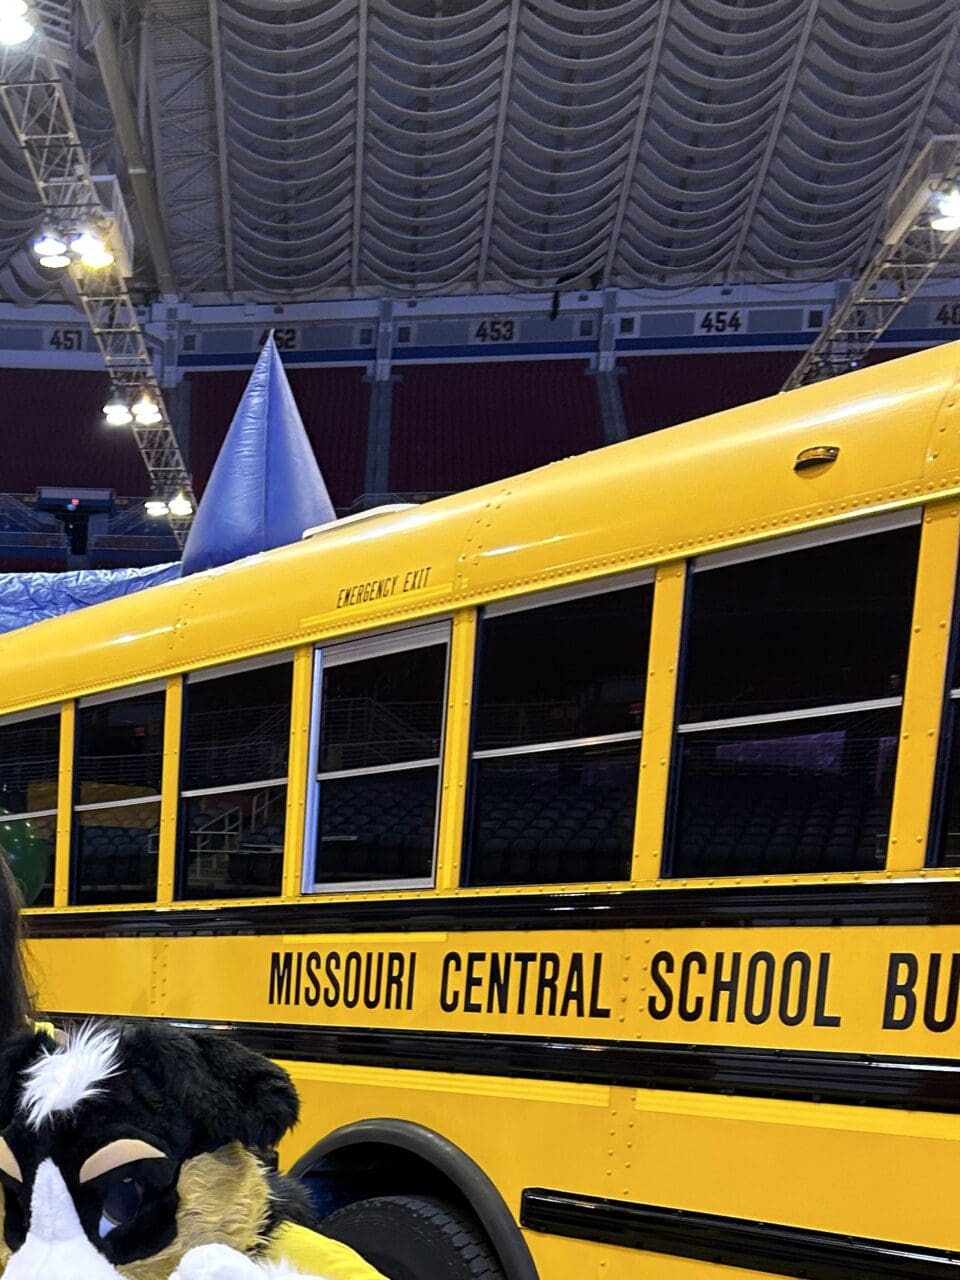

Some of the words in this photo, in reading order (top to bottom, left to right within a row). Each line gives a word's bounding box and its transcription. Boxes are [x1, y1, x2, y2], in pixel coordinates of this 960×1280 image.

[475, 319, 515, 342] 453
[700, 310, 743, 333] 454
[335, 575, 399, 609] EMERGENCY
[402, 566, 432, 593] EXIT
[268, 951, 417, 1011] MISSOURI
[439, 951, 611, 1019] CENTRAL
[647, 950, 842, 1028] SCHOOL
